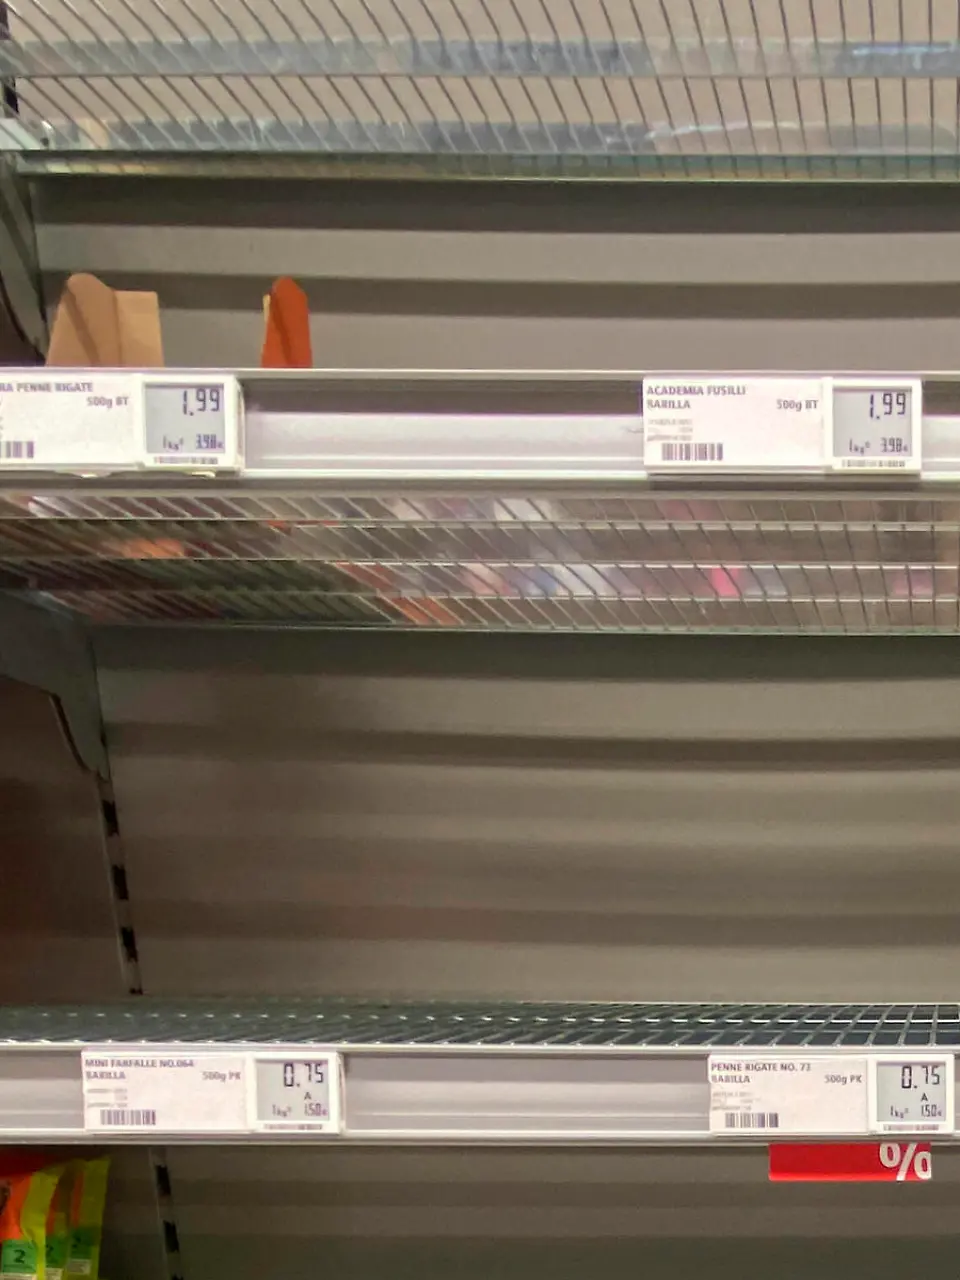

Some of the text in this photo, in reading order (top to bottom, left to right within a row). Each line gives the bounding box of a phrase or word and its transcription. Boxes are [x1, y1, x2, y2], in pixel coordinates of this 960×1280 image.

[647, 385, 746, 396] ACADEMIA FUSILLI
[183, 388, 221, 416] 1.99
[776, 399, 802, 411] 500g
[869, 392, 907, 420] 1.99
[111, 1059, 158, 1068] FARFALLE
[711, 1063, 743, 1072] PENNE
[745, 1063, 778, 1072] RIGATE
[283, 1062, 324, 1088] 0.75
[824, 1074, 862, 1086] 500g PK
[901, 1064, 940, 1089] 0.75
